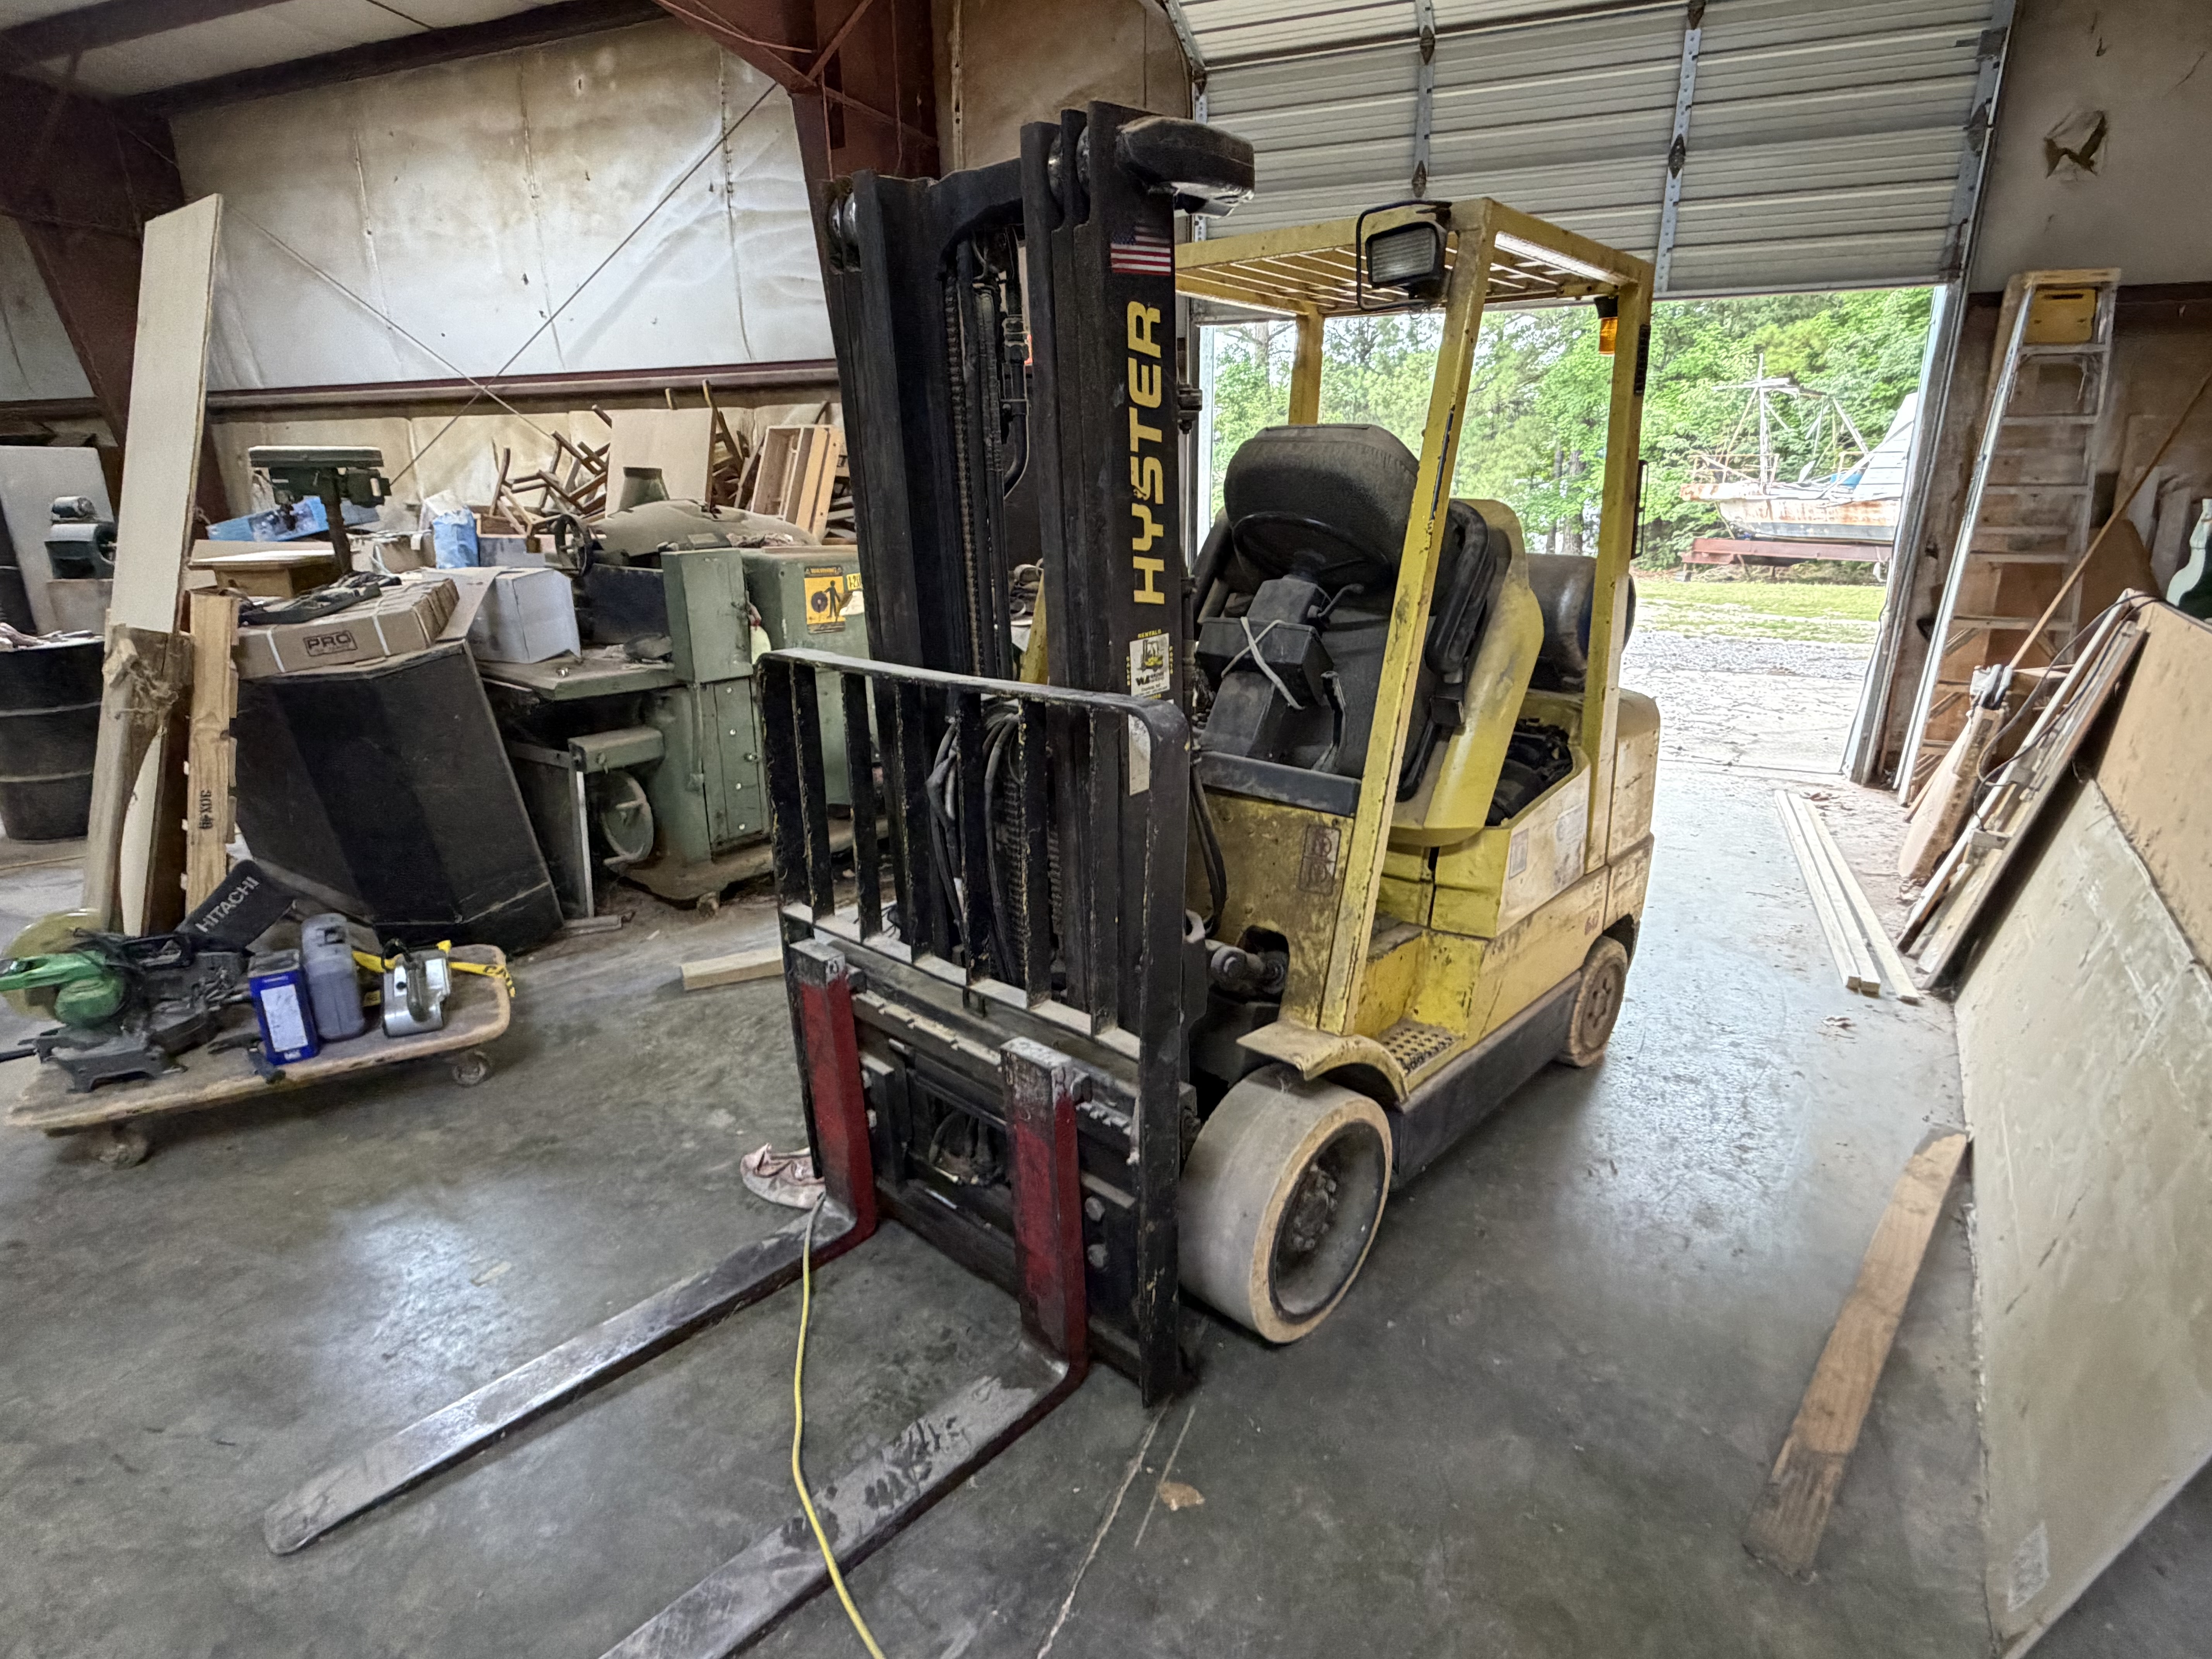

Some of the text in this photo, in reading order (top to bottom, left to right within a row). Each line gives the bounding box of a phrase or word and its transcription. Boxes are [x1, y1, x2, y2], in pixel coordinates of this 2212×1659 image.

[1127, 301, 1165, 605] HYSTER
[307, 634, 351, 650] PRO
[1137, 629, 1162, 639] RENTALS
[195, 876, 260, 933] HITACHI
